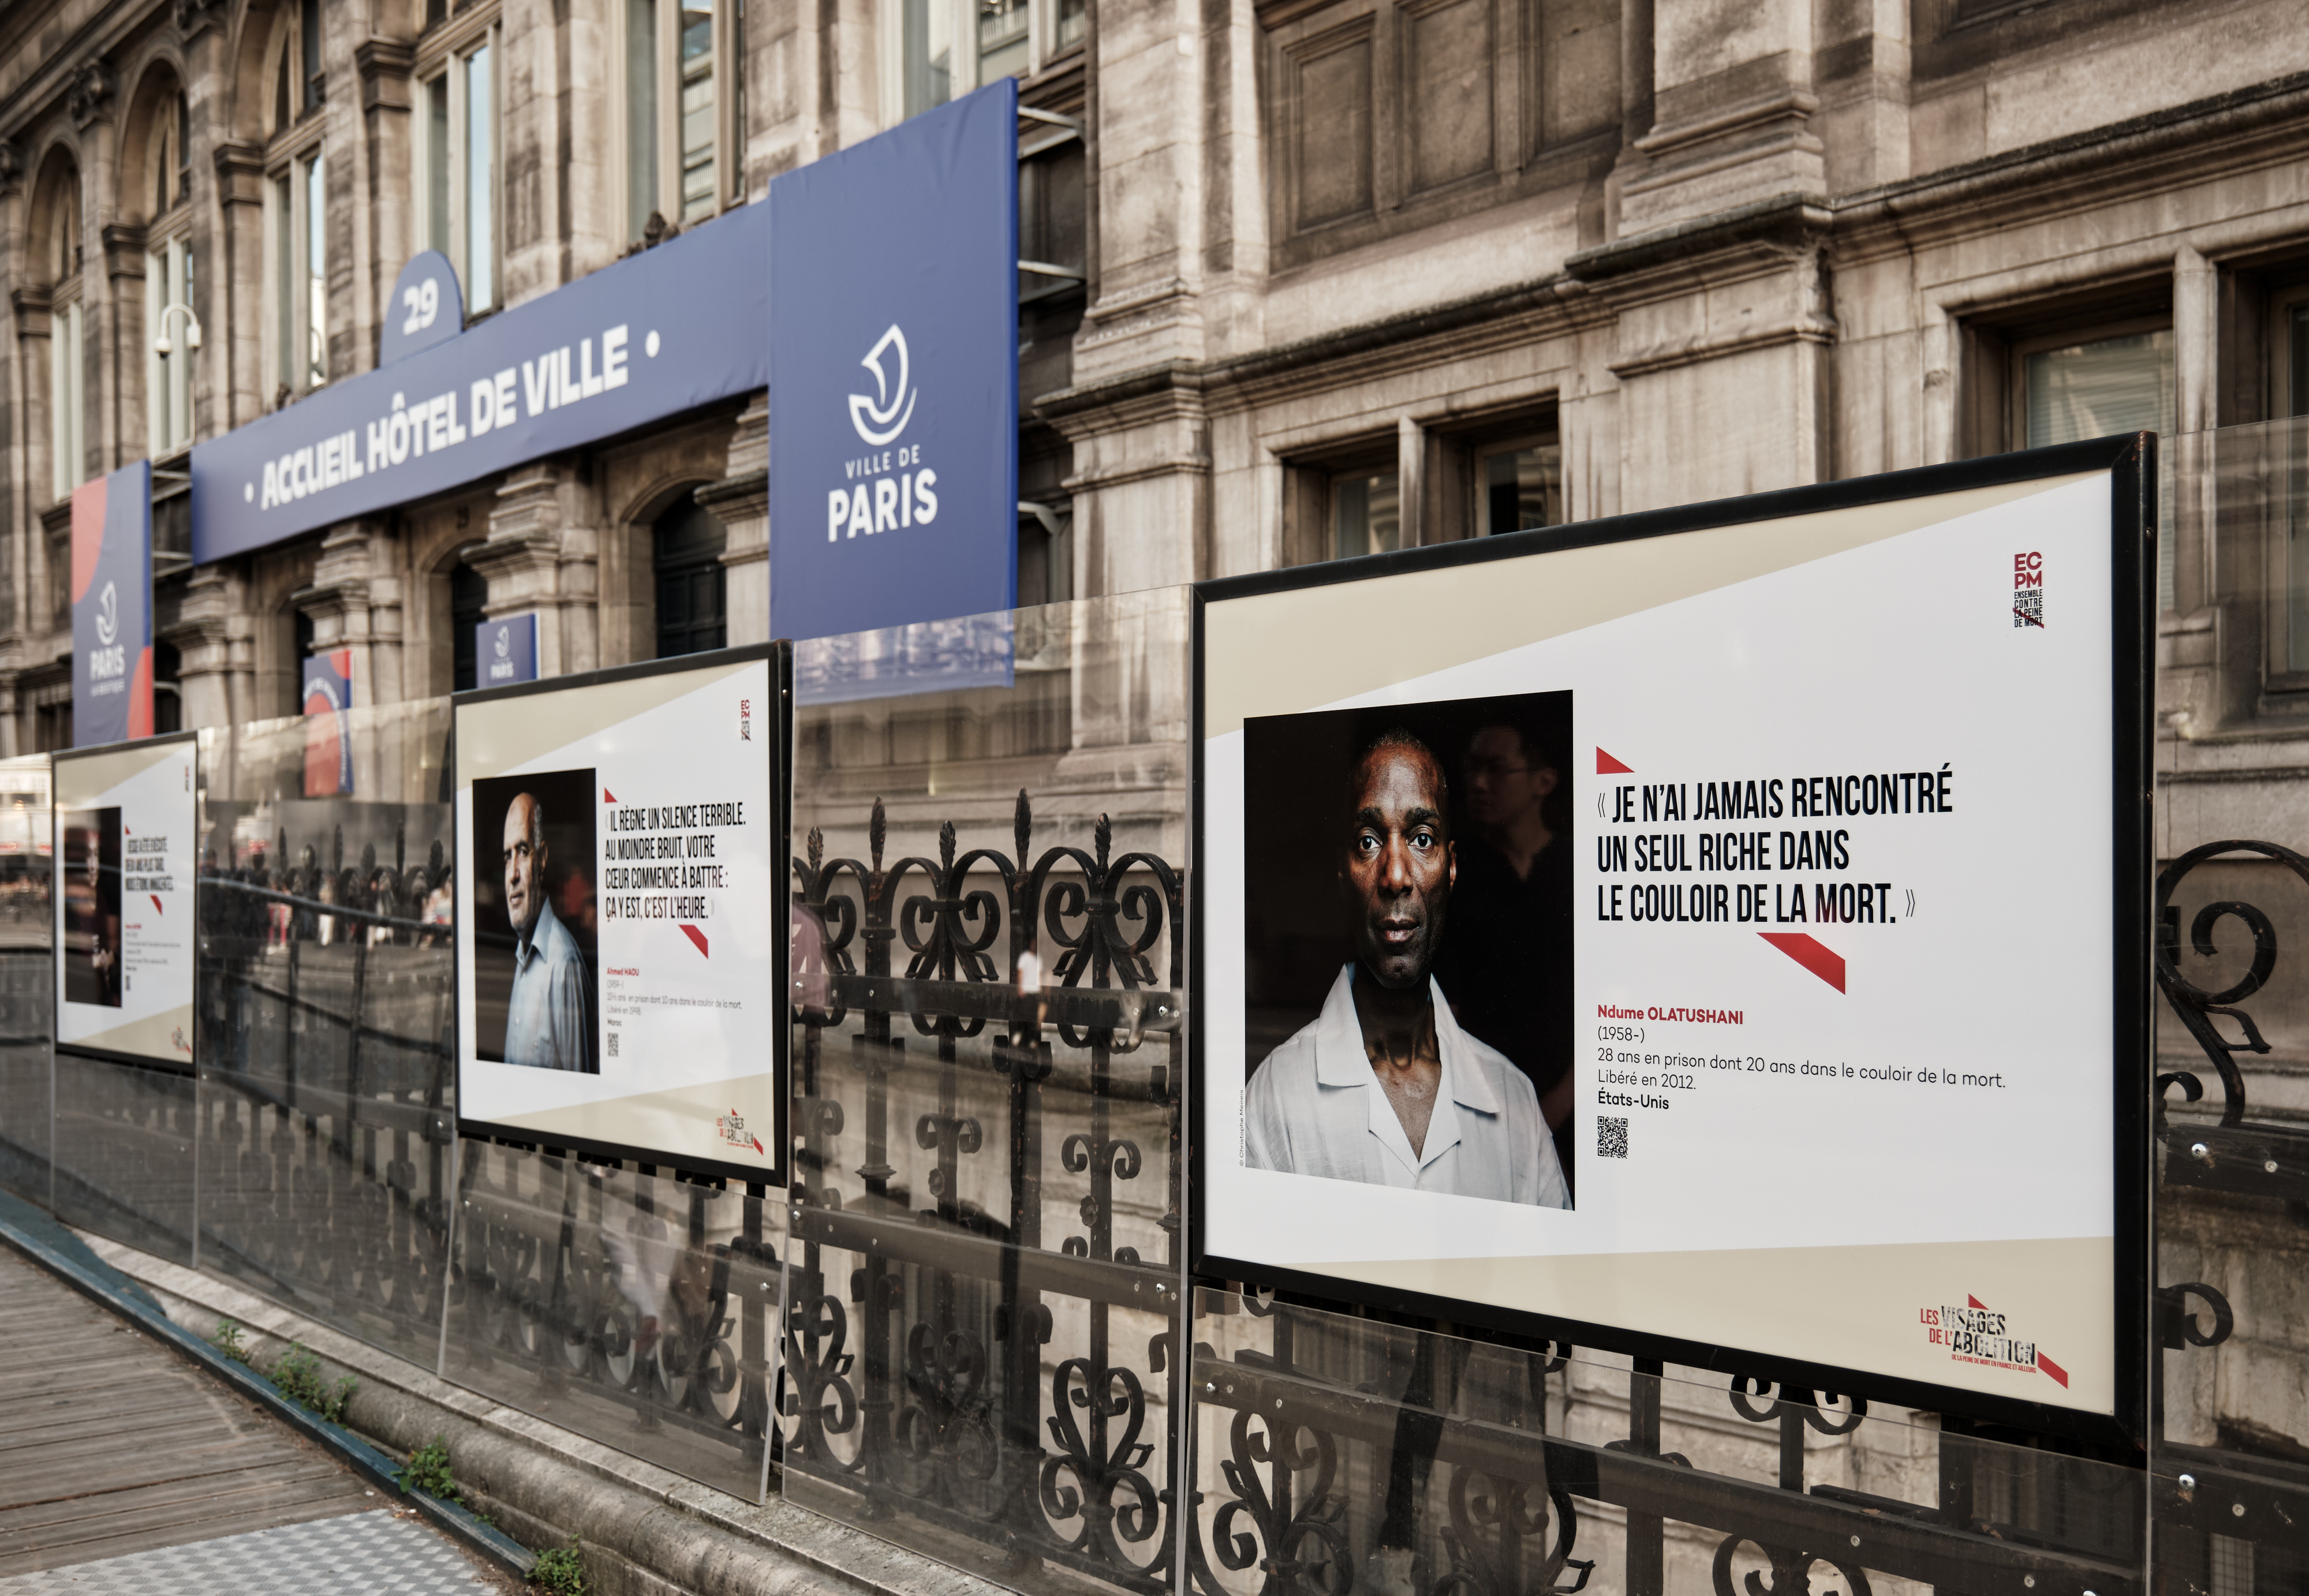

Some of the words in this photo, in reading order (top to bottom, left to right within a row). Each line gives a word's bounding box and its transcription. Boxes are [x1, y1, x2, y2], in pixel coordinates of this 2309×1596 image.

[403, 277, 439, 336] 29
[261, 429, 364, 511] ACCUEIL
[367, 391, 466, 473] HÔTEL
[470, 367, 517, 438] DE
[522, 323, 628, 417] VILLE
[845, 451, 891, 480] VILLE
[898, 444, 920, 468] DE
[828, 468, 938, 543] PARIS
[2015, 551, 2042, 572] EC
[2015, 570, 2042, 589] PM
[2015, 589, 2042, 599] ENSEMBLE
[2015, 597, 2042, 608] CONTRE
[2015, 609, 2022, 618] LA
[2024, 607, 2042, 617] PEINE
[2015, 618, 2022, 627] DE
[90, 645, 125, 681] PARIS
[741, 699, 750, 709] EC
[741, 711, 750, 719] PM
[1612, 786, 1635, 823] JE
[1694, 779, 1783, 821] JAMAIS
[1792, 763, 1952, 817] RENCONTRÉ
[611, 810, 617, 832] IL
[620, 805, 645, 831] RÈGNE
[648, 808, 659, 830] UN
[662, 805, 697, 829] SILENCE
[700, 802, 746, 827] TERRIBLE.
[606, 839, 615, 861] AU
[618, 837, 655, 860] MOINDRE
[657, 836, 684, 860] BRUIT,
[686, 835, 715, 858] VOTRE
[1597, 835, 1627, 872] UN
[1634, 833, 1692, 872] SEUL
[1699, 831, 1771, 871] RICHE
[1780, 829, 1849, 870] DANS
[606, 868, 629, 889] CŒUR
[632, 866, 679, 889] COMMENCE
[682, 860, 687, 888] À
[690, 865, 723, 888] BATTRE
[606, 896, 617, 922] ÇA
[618, 896, 624, 918] Y
[626, 896, 642, 921] EST,
[1598, 884, 1623, 921] LE
[1630, 884, 1729, 922] COULOIR
[1737, 883, 1768, 922] DE
[1776, 883, 1807, 922] LA
[1815, 883, 1896, 923] MORT.
[607, 967, 623, 976] Ahmed
[679, 996, 691, 1006] dans
[1598, 1005, 1644, 1021] Ndume
[1647, 1007, 1743, 1025] OLATUSHANI
[1597, 1026, 1645, 1043] (1958-)
[1598, 1048, 1613, 1062] 28
[1617, 1052, 1640, 1064] ans
[1645, 1054, 1660, 1065] en
[1665, 1053, 1705, 1070] prison
[1710, 1054, 1742, 1071] dont
[1747, 1056, 1765, 1072] 20
[1769, 1061, 1796, 1074] ans
[1800, 1060, 1837, 1077] dans
[1841, 1061, 1854, 1078] le
[1859, 1066, 1913, 1082] couloir
[1917, 1066, 1937, 1083] de
[1942, 1068, 1956, 1085] la
[1963, 1072, 2006, 1088] mort.
[1598, 1069, 1637, 1086] Libéré
[1641, 1076, 1657, 1086] en
[1661, 1074, 1696, 1090] 2012.
[1598, 1087, 1669, 1110] États-Unis
[1921, 1308, 1938, 1325] LES
[1941, 1306, 2005, 1336] VISAGES
[1929, 1328, 1942, 1344] DE
[2018, 1365, 2037, 1373] AILLEURS
